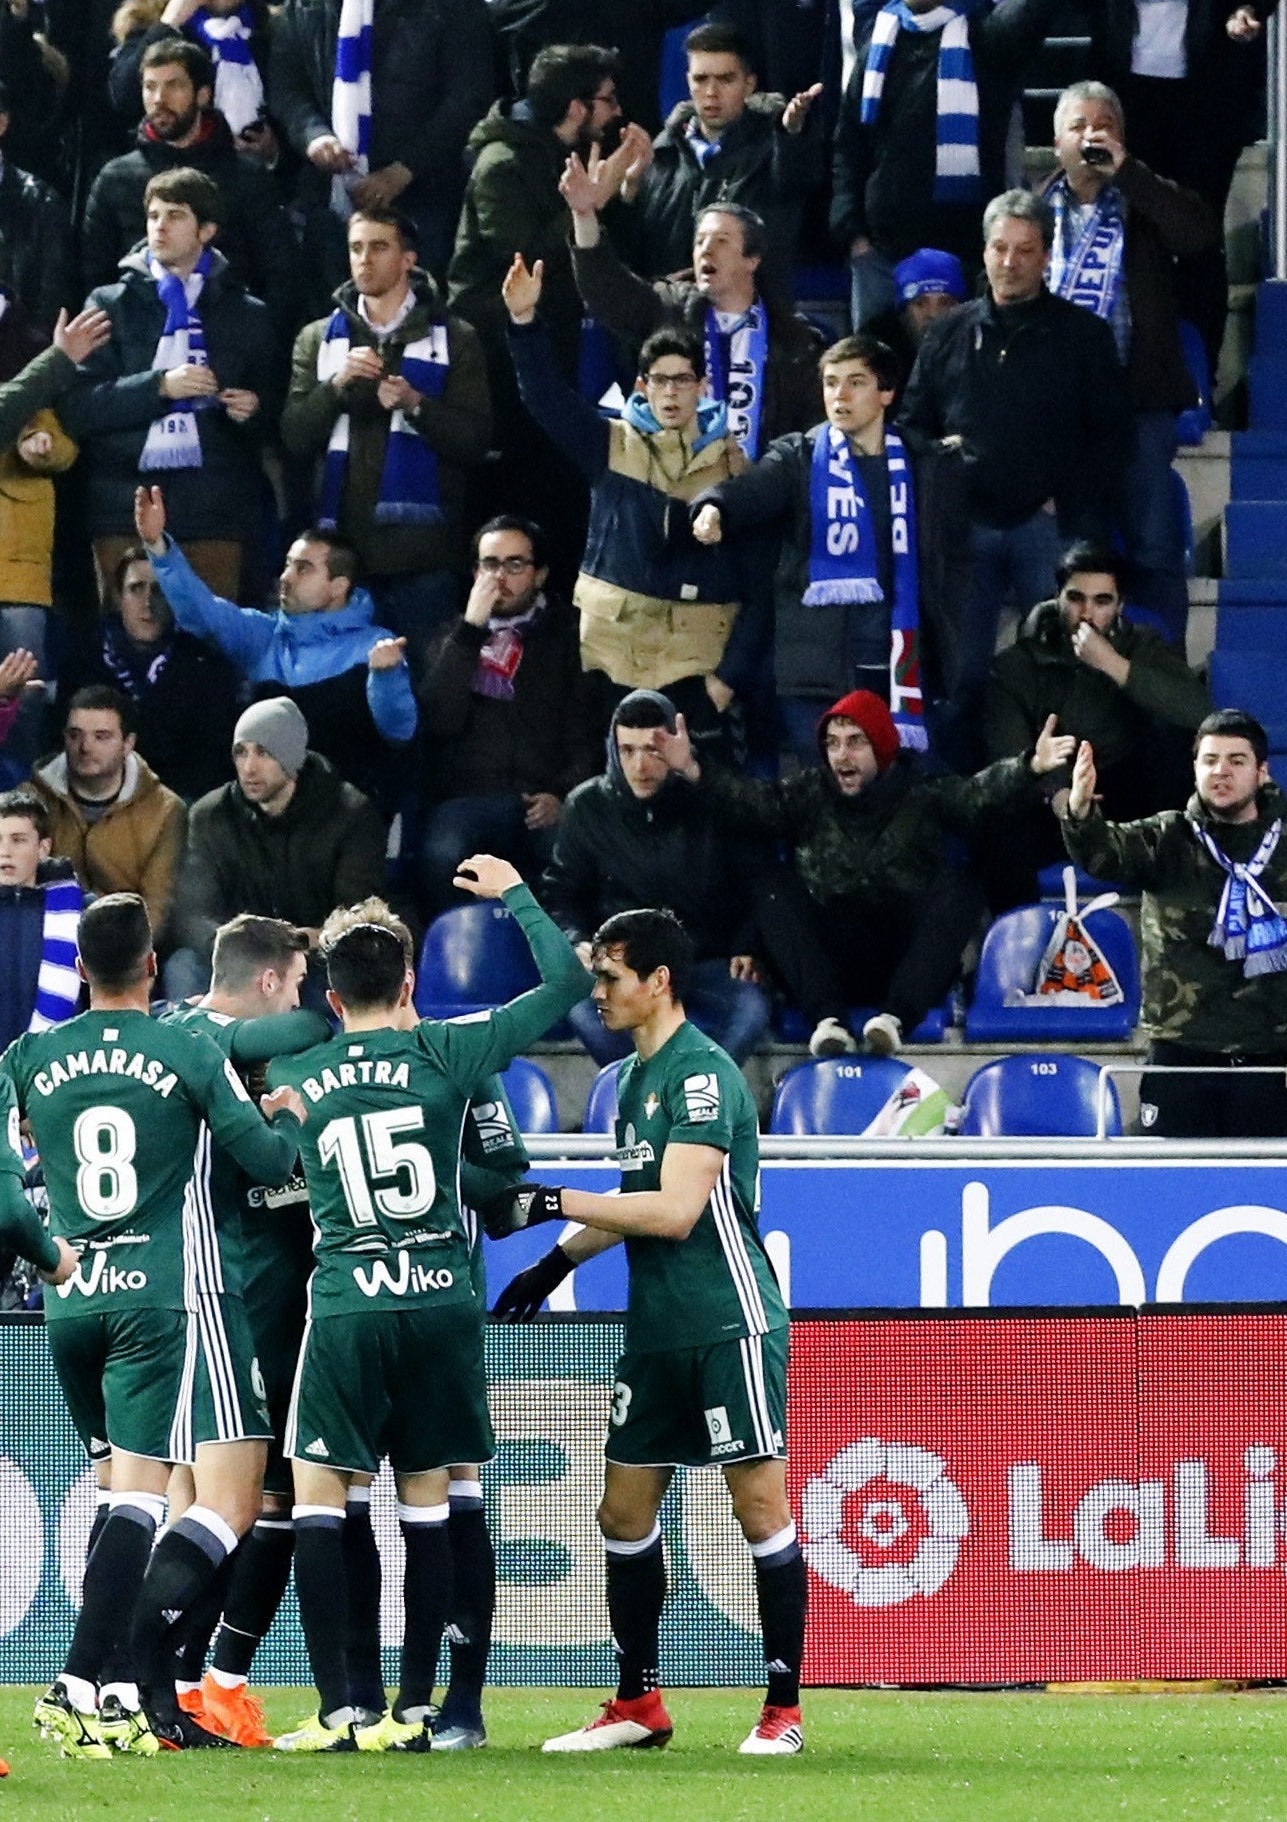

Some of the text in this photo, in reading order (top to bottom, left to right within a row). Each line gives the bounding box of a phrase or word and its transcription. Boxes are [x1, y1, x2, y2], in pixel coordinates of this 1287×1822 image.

[33, 1048, 179, 1099] CAMARASA
[301, 1060, 410, 1103] BARTRA
[835, 1065, 861, 1079] 101
[1029, 1062, 1057, 1076] 103
[73, 1105, 138, 1222] 8
[317, 1104, 437, 1229] 15
[545, 1195, 560, 1212] 23
[56, 1250, 148, 1299] Wiko
[352, 1250, 454, 1297] Wiko
